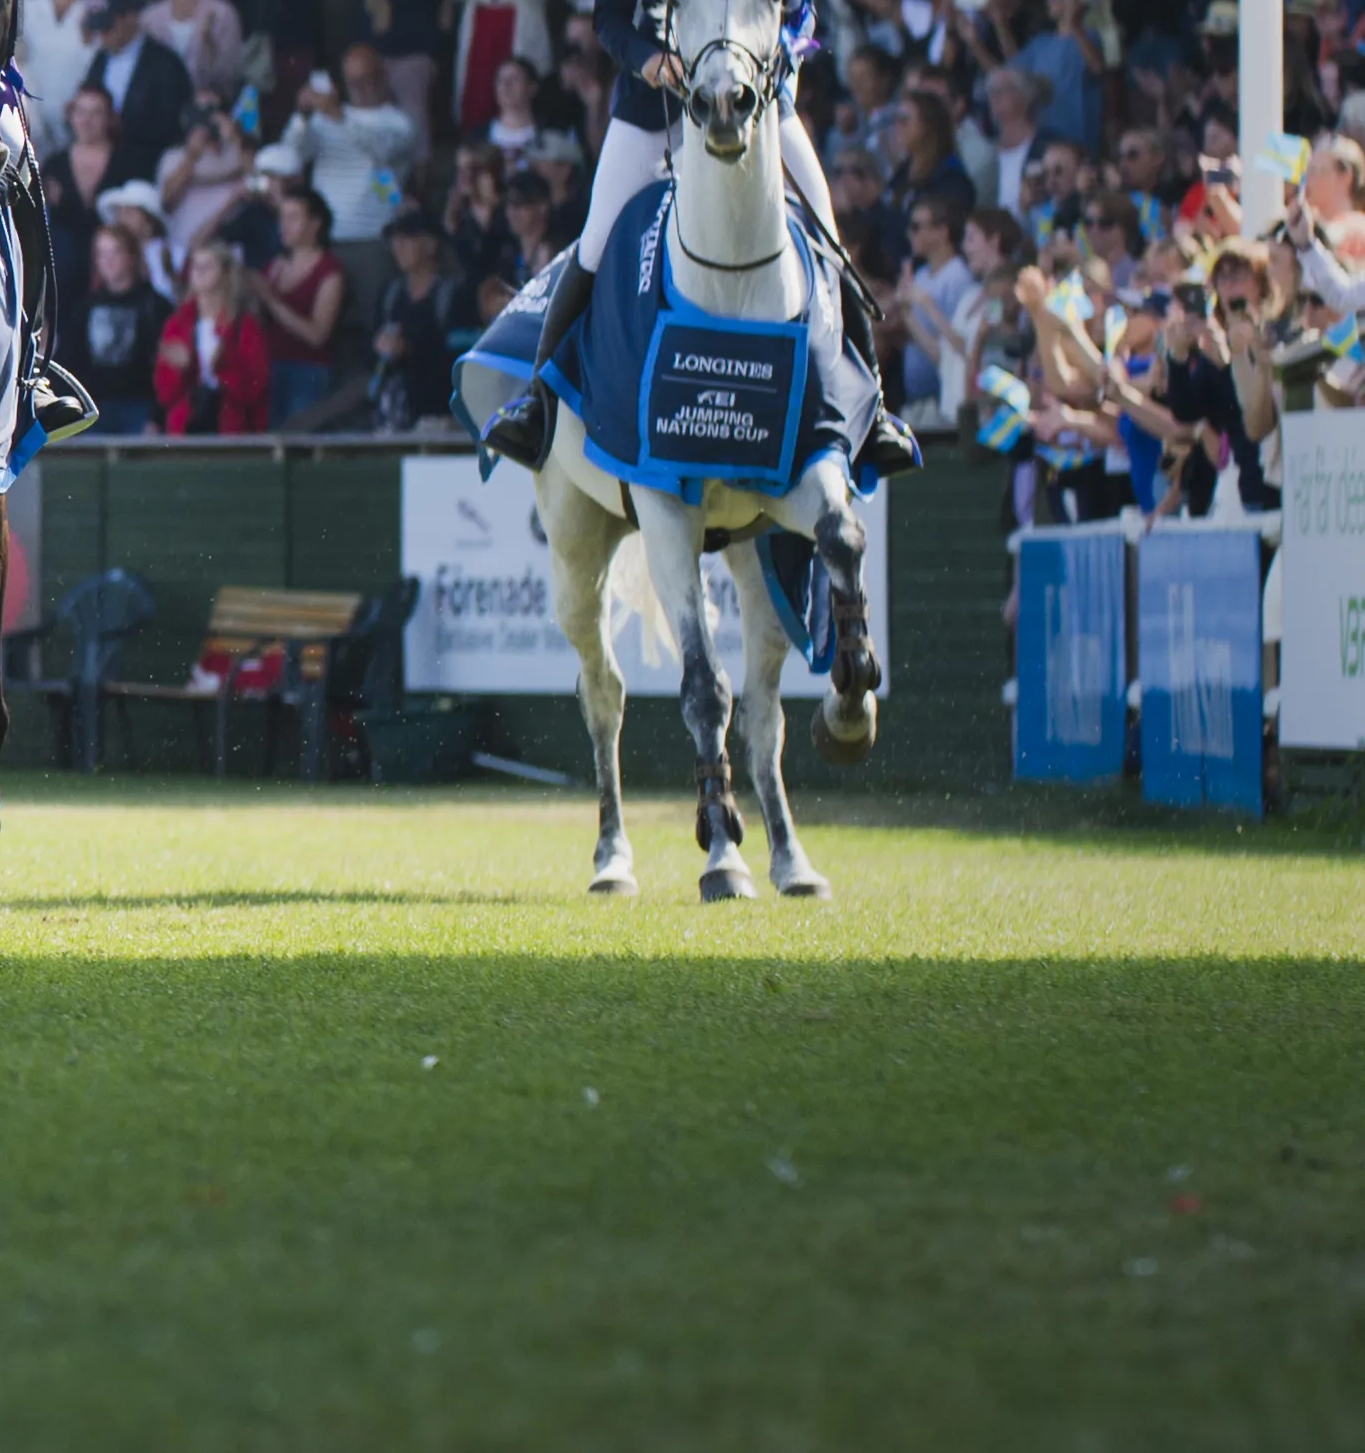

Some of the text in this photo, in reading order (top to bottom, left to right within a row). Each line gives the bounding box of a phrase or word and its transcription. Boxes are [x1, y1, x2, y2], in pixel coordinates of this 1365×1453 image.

[673, 352, 773, 380] LONGINES
[675, 405, 753, 428] JUMPING
[656, 417, 769, 443] NATIONS CUP
